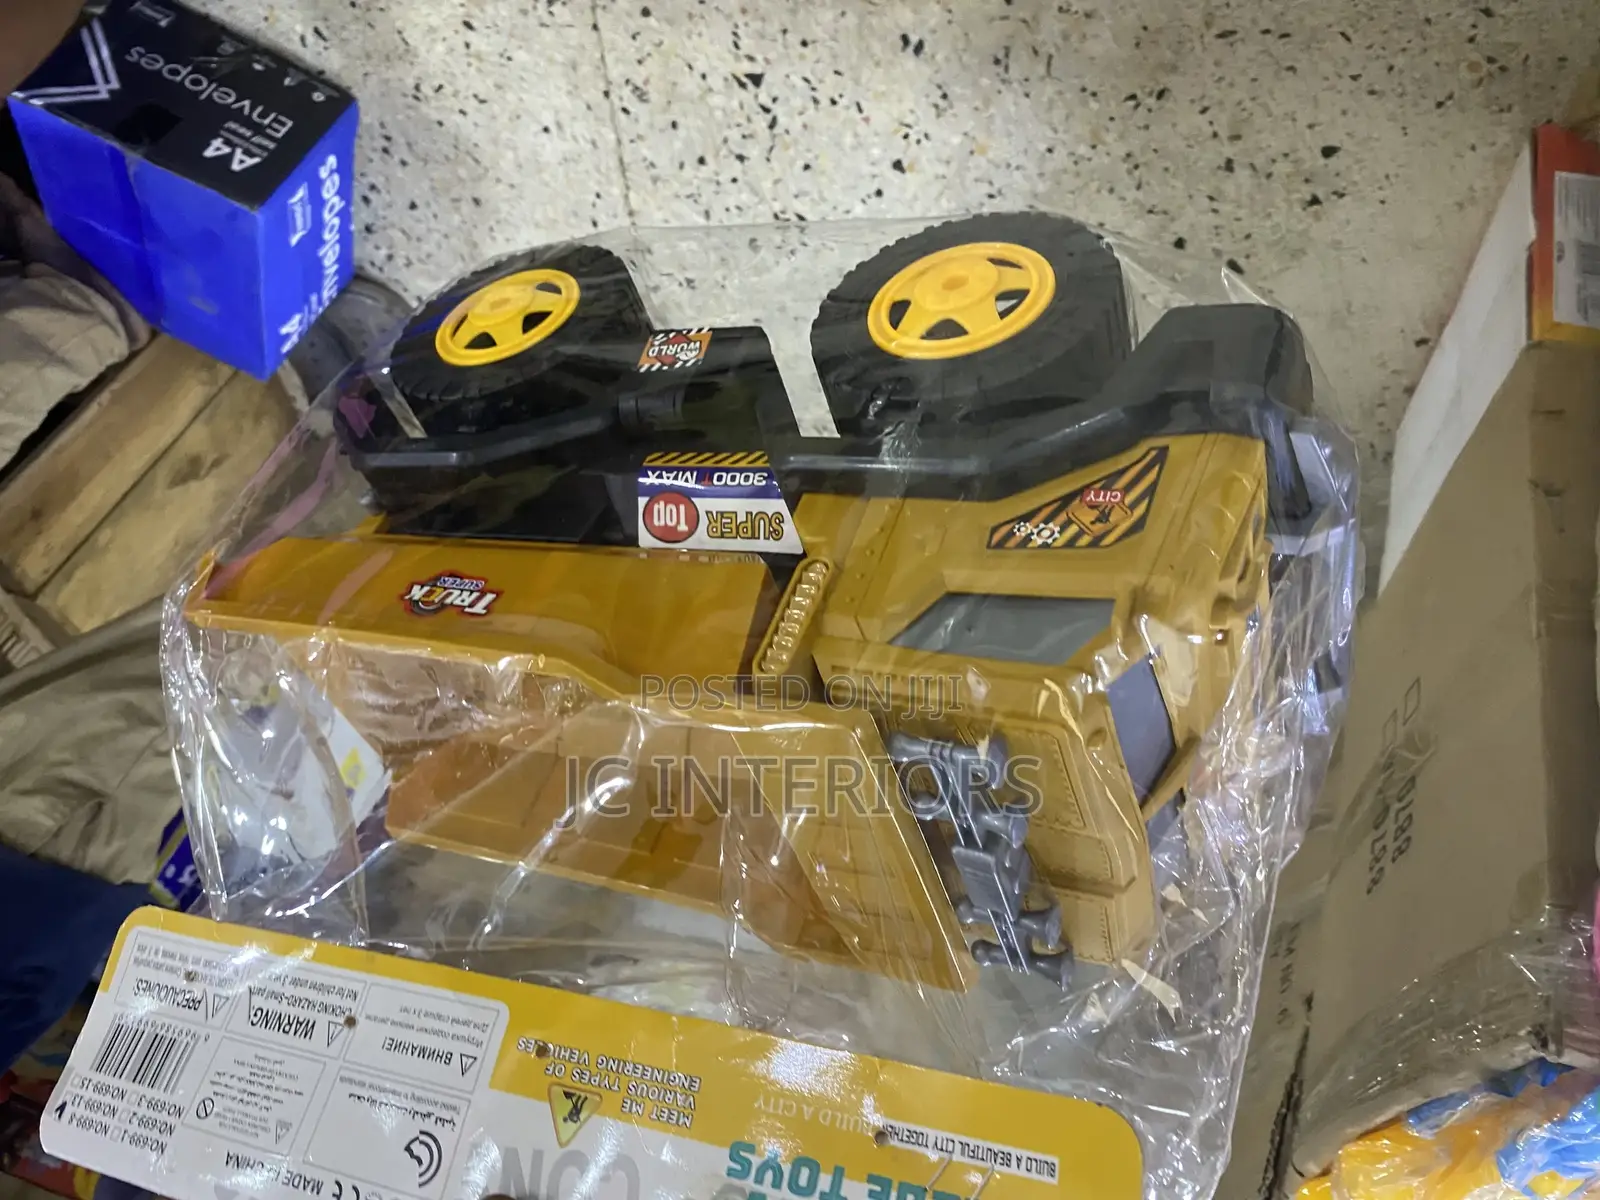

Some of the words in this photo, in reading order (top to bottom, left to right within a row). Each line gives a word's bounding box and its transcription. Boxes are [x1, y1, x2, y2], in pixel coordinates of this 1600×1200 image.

[124, 46, 293, 139] Envelopes
[202, 138, 262, 172] A4
[648, 341, 701, 359] WORLD
[1086, 490, 1121, 502] CITY
[653, 501, 688, 531] Top
[705, 510, 784, 541] SUPER
[404, 584, 497, 615] TRUCK
[382, 1036, 453, 1066] ВНИМАНИЕ!
[544, 1062, 566, 1078] OF
[572, 1066, 621, 1092] TYPES
[596, 1055, 701, 1092] ENGINEERING
[81, 1077, 127, 1102] NO:699-15
[627, 1081, 695, 1111] VARIOUS
[72, 1094, 118, 1119] NO:699-13
[138, 1094, 185, 1119] NO:699-3
[621, 1098, 644, 1116] ME
[648, 1106, 693, 1128] MEET
[753, 1093, 798, 1117] CITY
[68, 1113, 110, 1137] NO:699-8
[129, 1112, 176, 1136] NO:699-2
[121, 1129, 167, 1155] NO:699-1
[933, 1135, 955, 1154] CITY
[957, 1140, 1012, 1167] BEAUTIFUL
[726, 1141, 847, 1200] TOYS
[1014, 1154, 1023, 1169] A
[1025, 1156, 1057, 1178] BUILD
[282, 1170, 324, 1196] MADE
